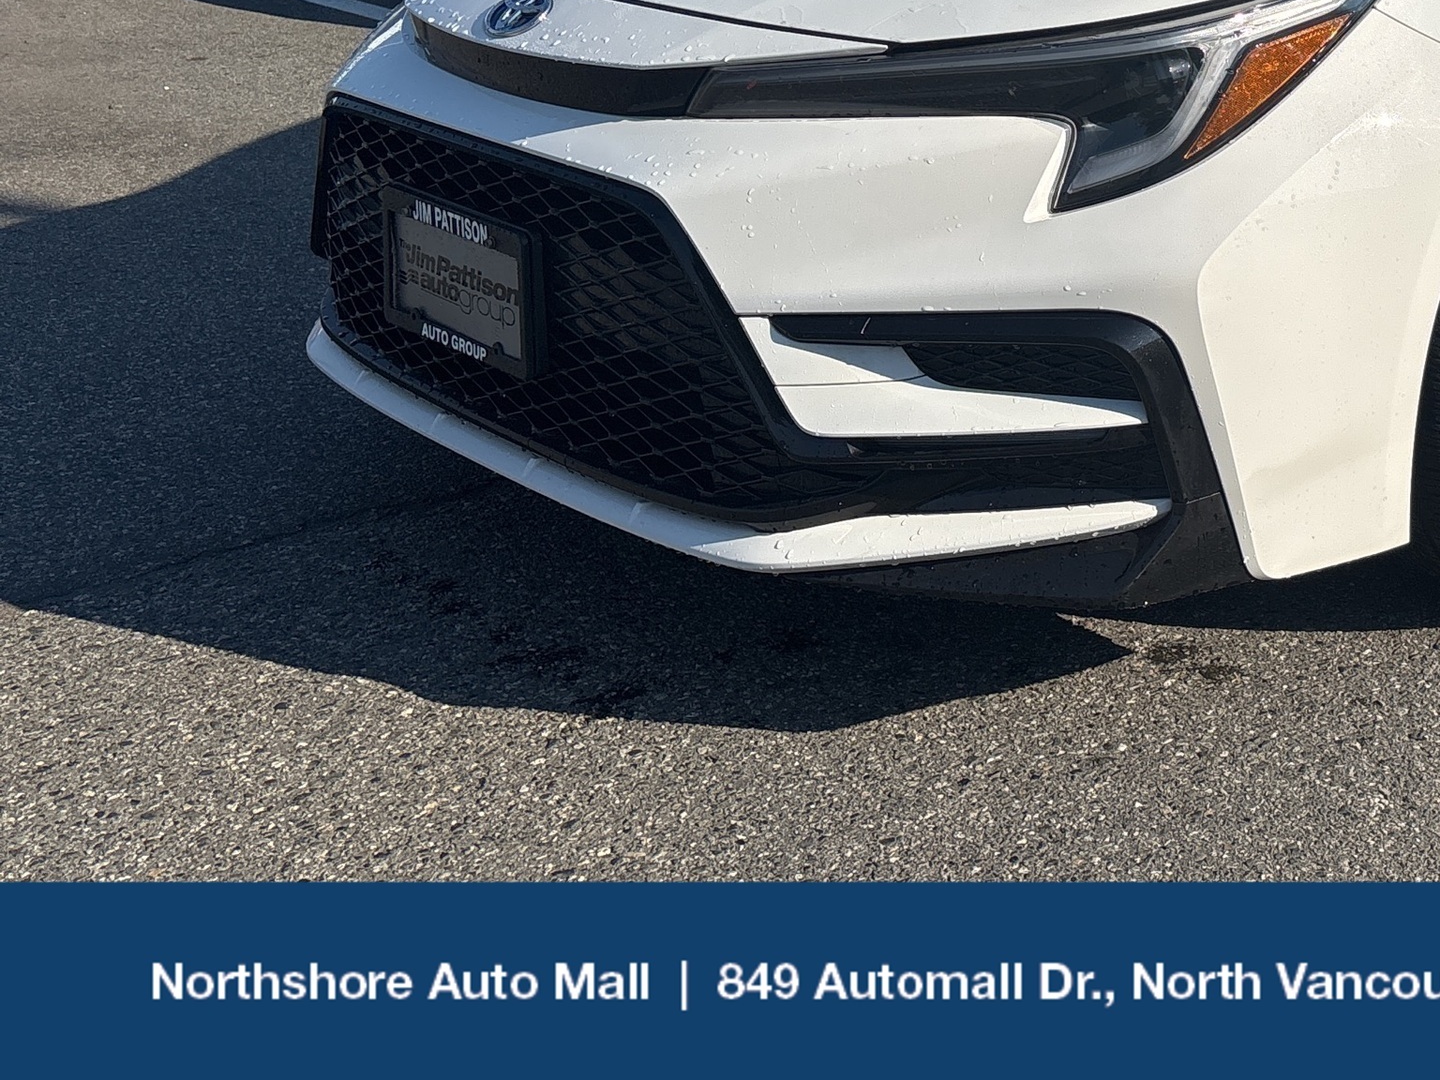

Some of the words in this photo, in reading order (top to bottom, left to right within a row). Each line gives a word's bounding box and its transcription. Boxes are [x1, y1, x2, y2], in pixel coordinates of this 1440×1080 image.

[413, 199, 432, 225] JIM
[434, 206, 488, 245] PATTISON
[421, 322, 449, 346] AUTO
[451, 334, 487, 362] GROUP
